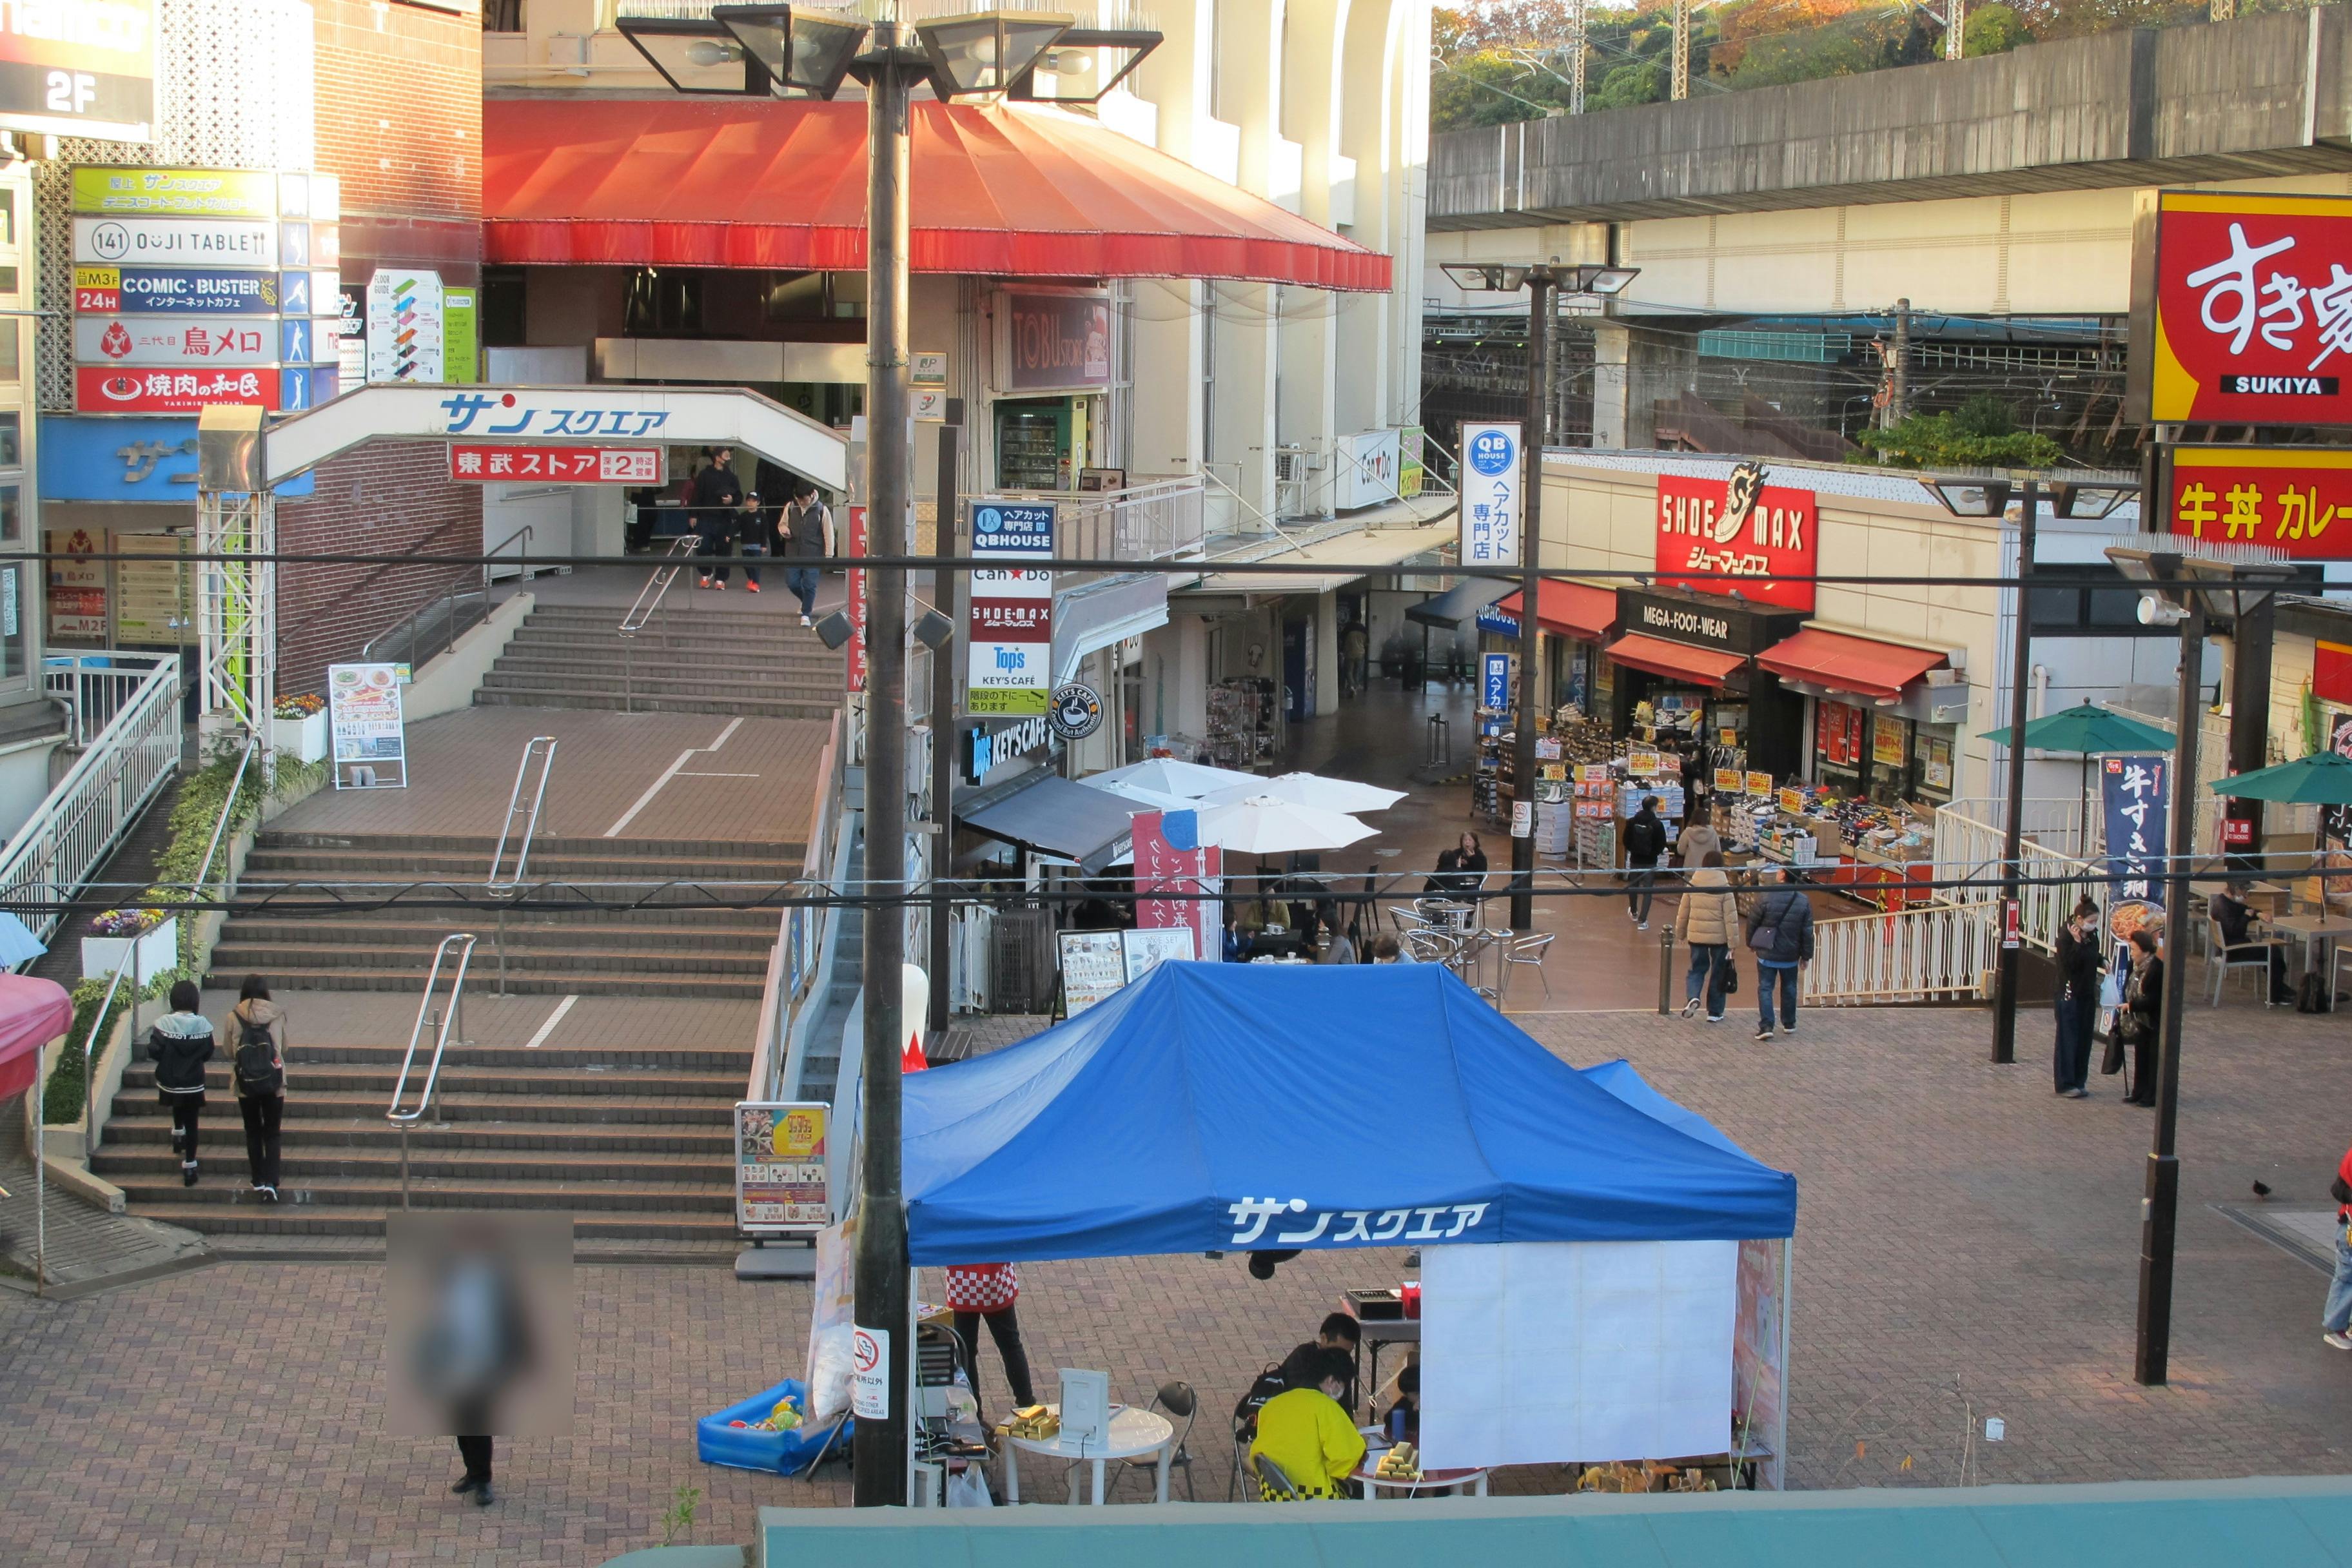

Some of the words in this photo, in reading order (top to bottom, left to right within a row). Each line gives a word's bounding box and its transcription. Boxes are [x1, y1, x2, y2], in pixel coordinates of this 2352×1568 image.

[47, 71, 95, 113] 2F
[110, 177, 135, 190] 屋上
[144, 173, 221, 191] サンスクエア
[97, 233, 124, 250] 141
[192, 234, 248, 251] TABLE
[88, 274, 118, 286] M3F
[375, 275, 390, 284] FLOOR
[375, 285, 389, 294] GUIDE
[79, 293, 117, 309] 24H
[146, 297, 240, 308] インターネットカフェ
[139, 336, 177, 346] 三代目
[182, 326, 262, 357] 鳥メロ
[1013, 311, 1060, 369] TOBU
[145, 373, 260, 397] 焼肉の和民
[2235, 377, 2322, 395] SUKIYA
[440, 393, 672, 436] サンスクエア
[1478, 437, 1505, 453] QB
[457, 452, 596, 476] 東武ストア
[615, 455, 632, 475] 2
[1004, 509, 1050, 520] ヘアカット
[1493, 480, 1510, 560] ヘアカット
[2179, 482, 2263, 539] 牛丼
[1004, 520, 1033, 532] 専門店
[1473, 503, 1491, 560] 専門店
[1661, 495, 1715, 538] SHOE
[1753, 505, 1803, 551] MAX
[1686, 546, 1770, 576] シューマックス
[1643, 605, 1729, 640] MEGA-FOOT-WEAR
[982, 676, 1010, 685] KEY'S
[970, 691, 1017, 700] 階段の下に
[1056, 688, 1075, 701] KEY'S
[970, 702, 1008, 711] あります
[1063, 727, 1074, 736] But
[1074, 714, 1097, 736] Authentic
[992, 724, 1023, 767] KEY'S
[1228, 1197, 1491, 1244] サンスクエア
